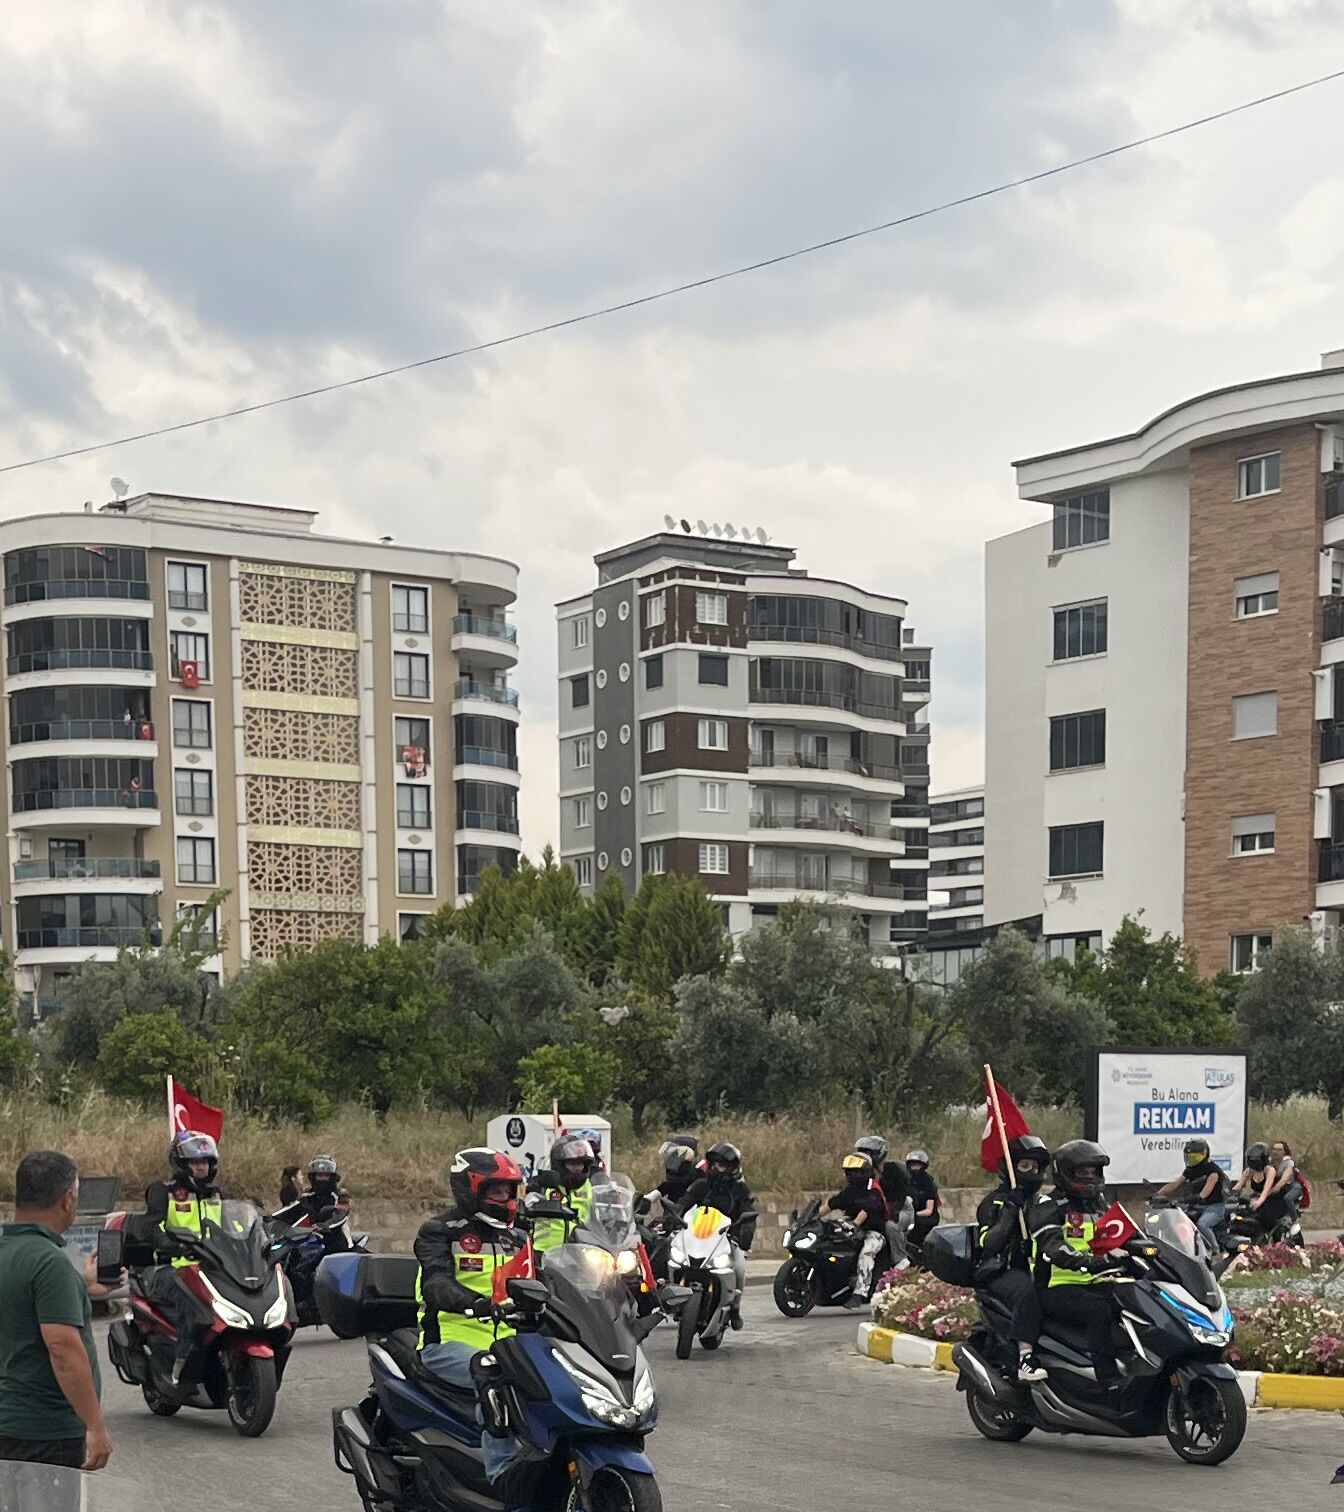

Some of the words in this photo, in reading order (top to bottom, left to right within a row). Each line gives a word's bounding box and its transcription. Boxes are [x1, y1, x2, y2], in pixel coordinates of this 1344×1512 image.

[1151, 1088, 1165, 1101] Bu
[1168, 1088, 1199, 1101] Alana
[1139, 1107, 1211, 1129] REKLAM
[1141, 1138, 1188, 1151] Verebilir
